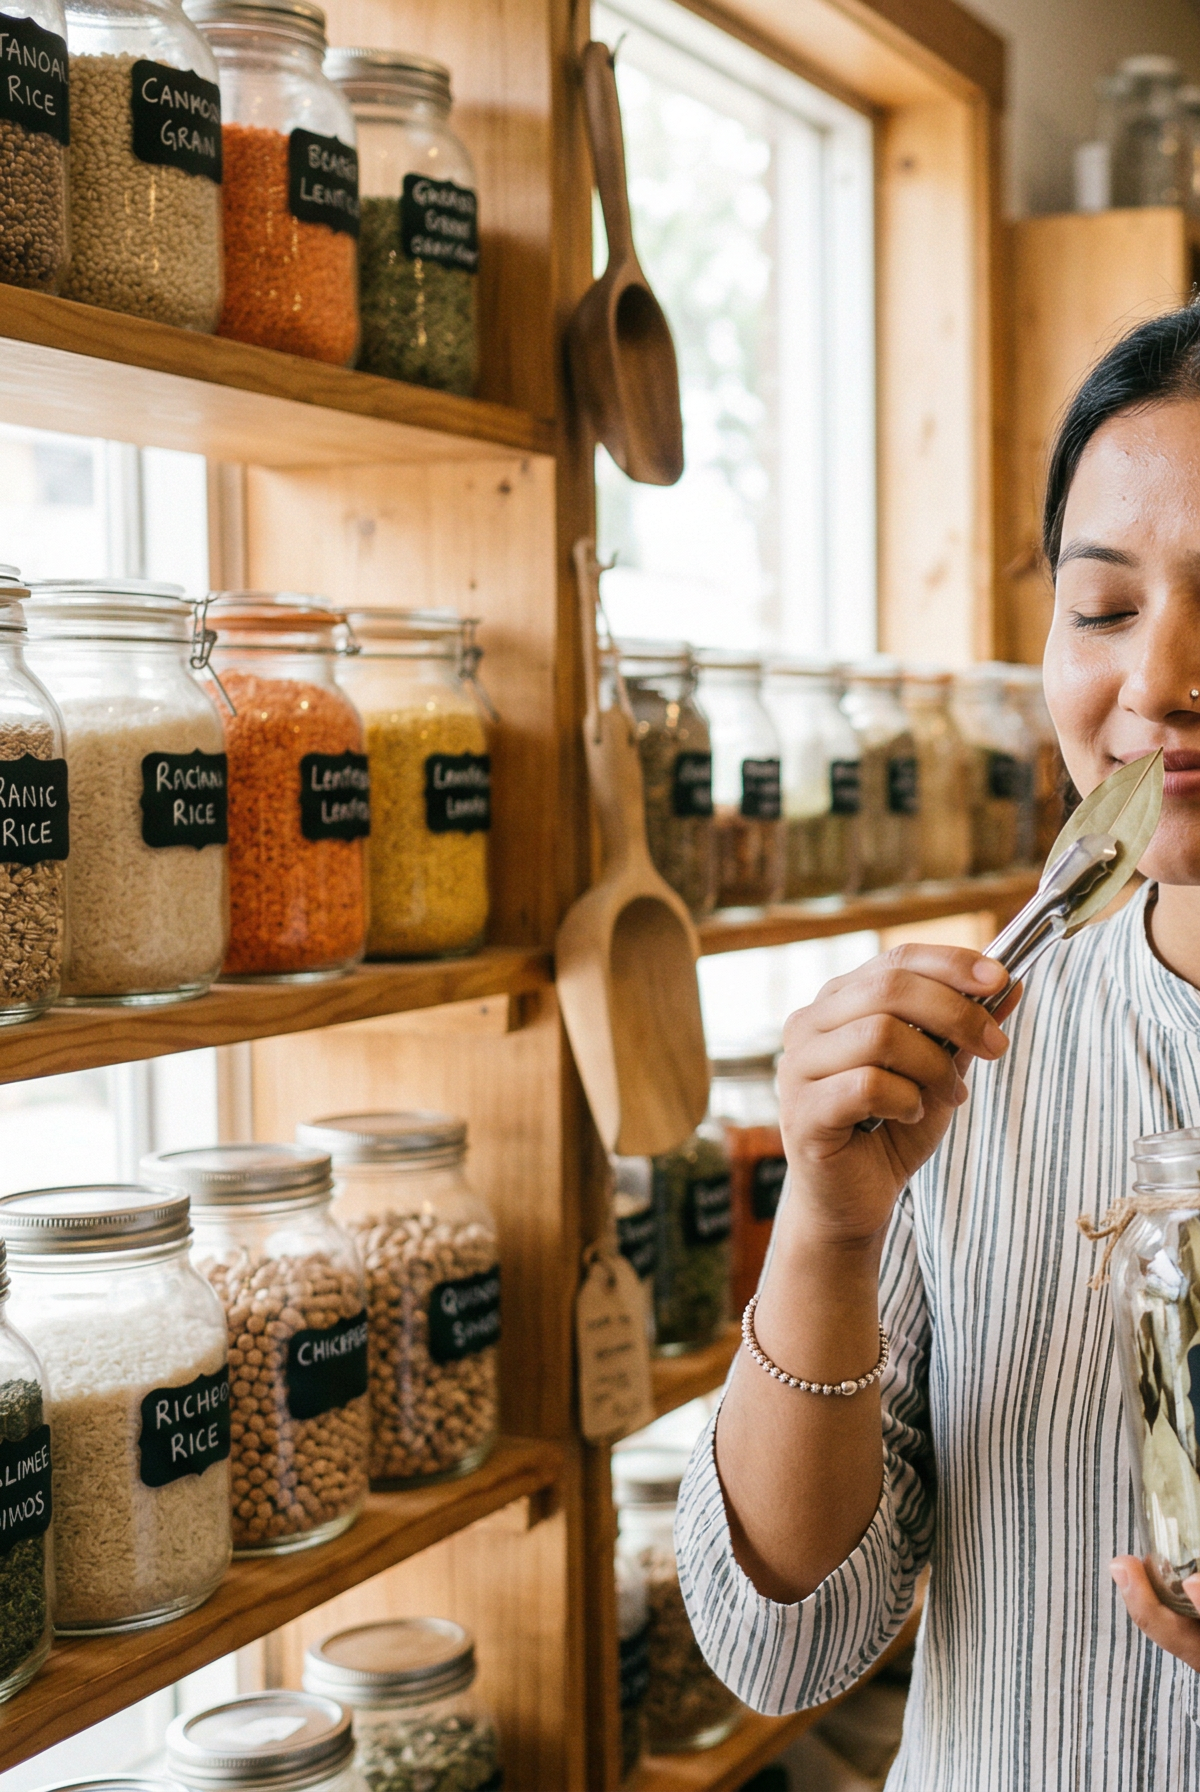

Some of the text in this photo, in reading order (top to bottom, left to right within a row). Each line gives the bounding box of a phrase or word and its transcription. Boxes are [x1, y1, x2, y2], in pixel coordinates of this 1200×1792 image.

[8, 75, 56, 116] RICE
[173, 798, 216, 826] RICE
[3, 818, 53, 847] RICE
[171, 1423, 219, 1463] RICE
